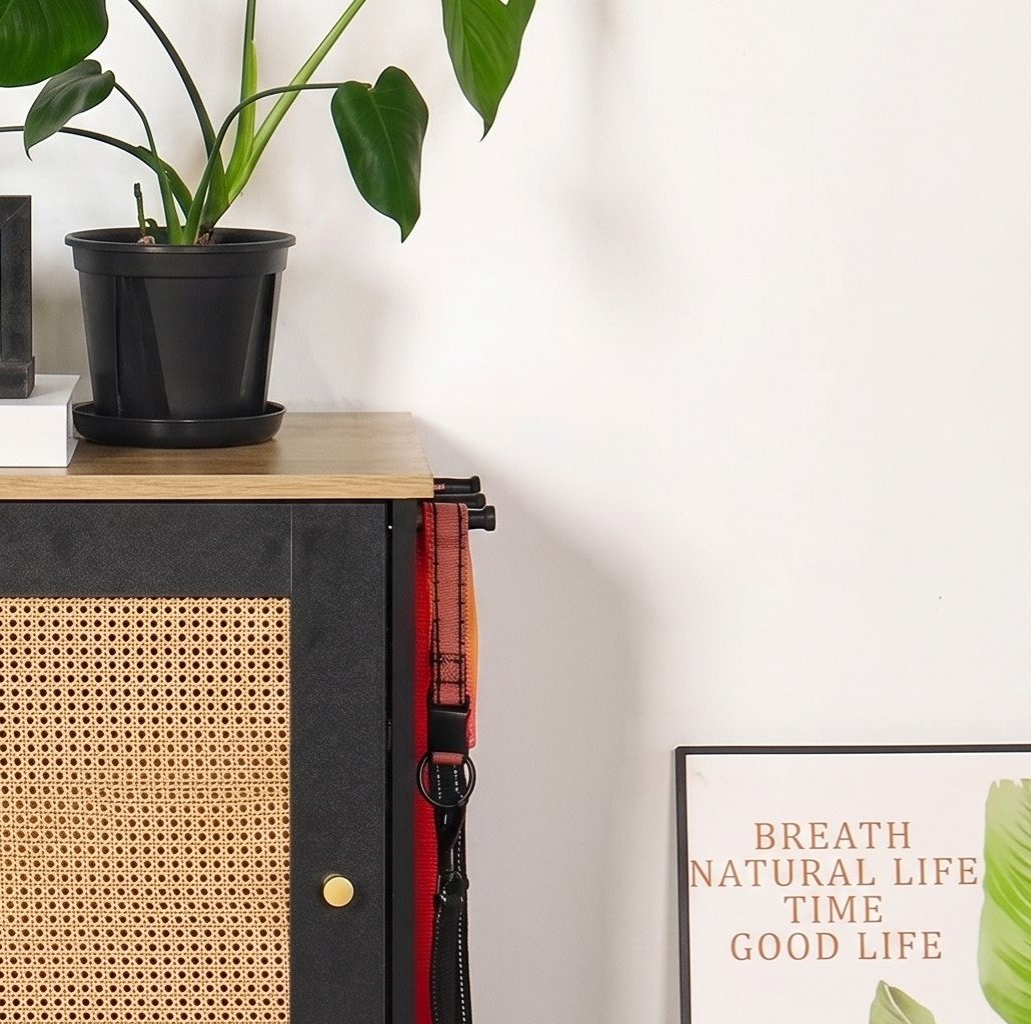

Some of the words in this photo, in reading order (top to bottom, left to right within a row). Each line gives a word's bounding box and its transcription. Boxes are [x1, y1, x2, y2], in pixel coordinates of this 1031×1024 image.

[754, 821, 911, 850] BREATH
[690, 858, 876, 888] NATURAL
[893, 857, 978, 886] LIFE
[783, 895, 883, 924] TIME
[730, 932, 839, 961] GOOD
[857, 931, 942, 960] LIFE
